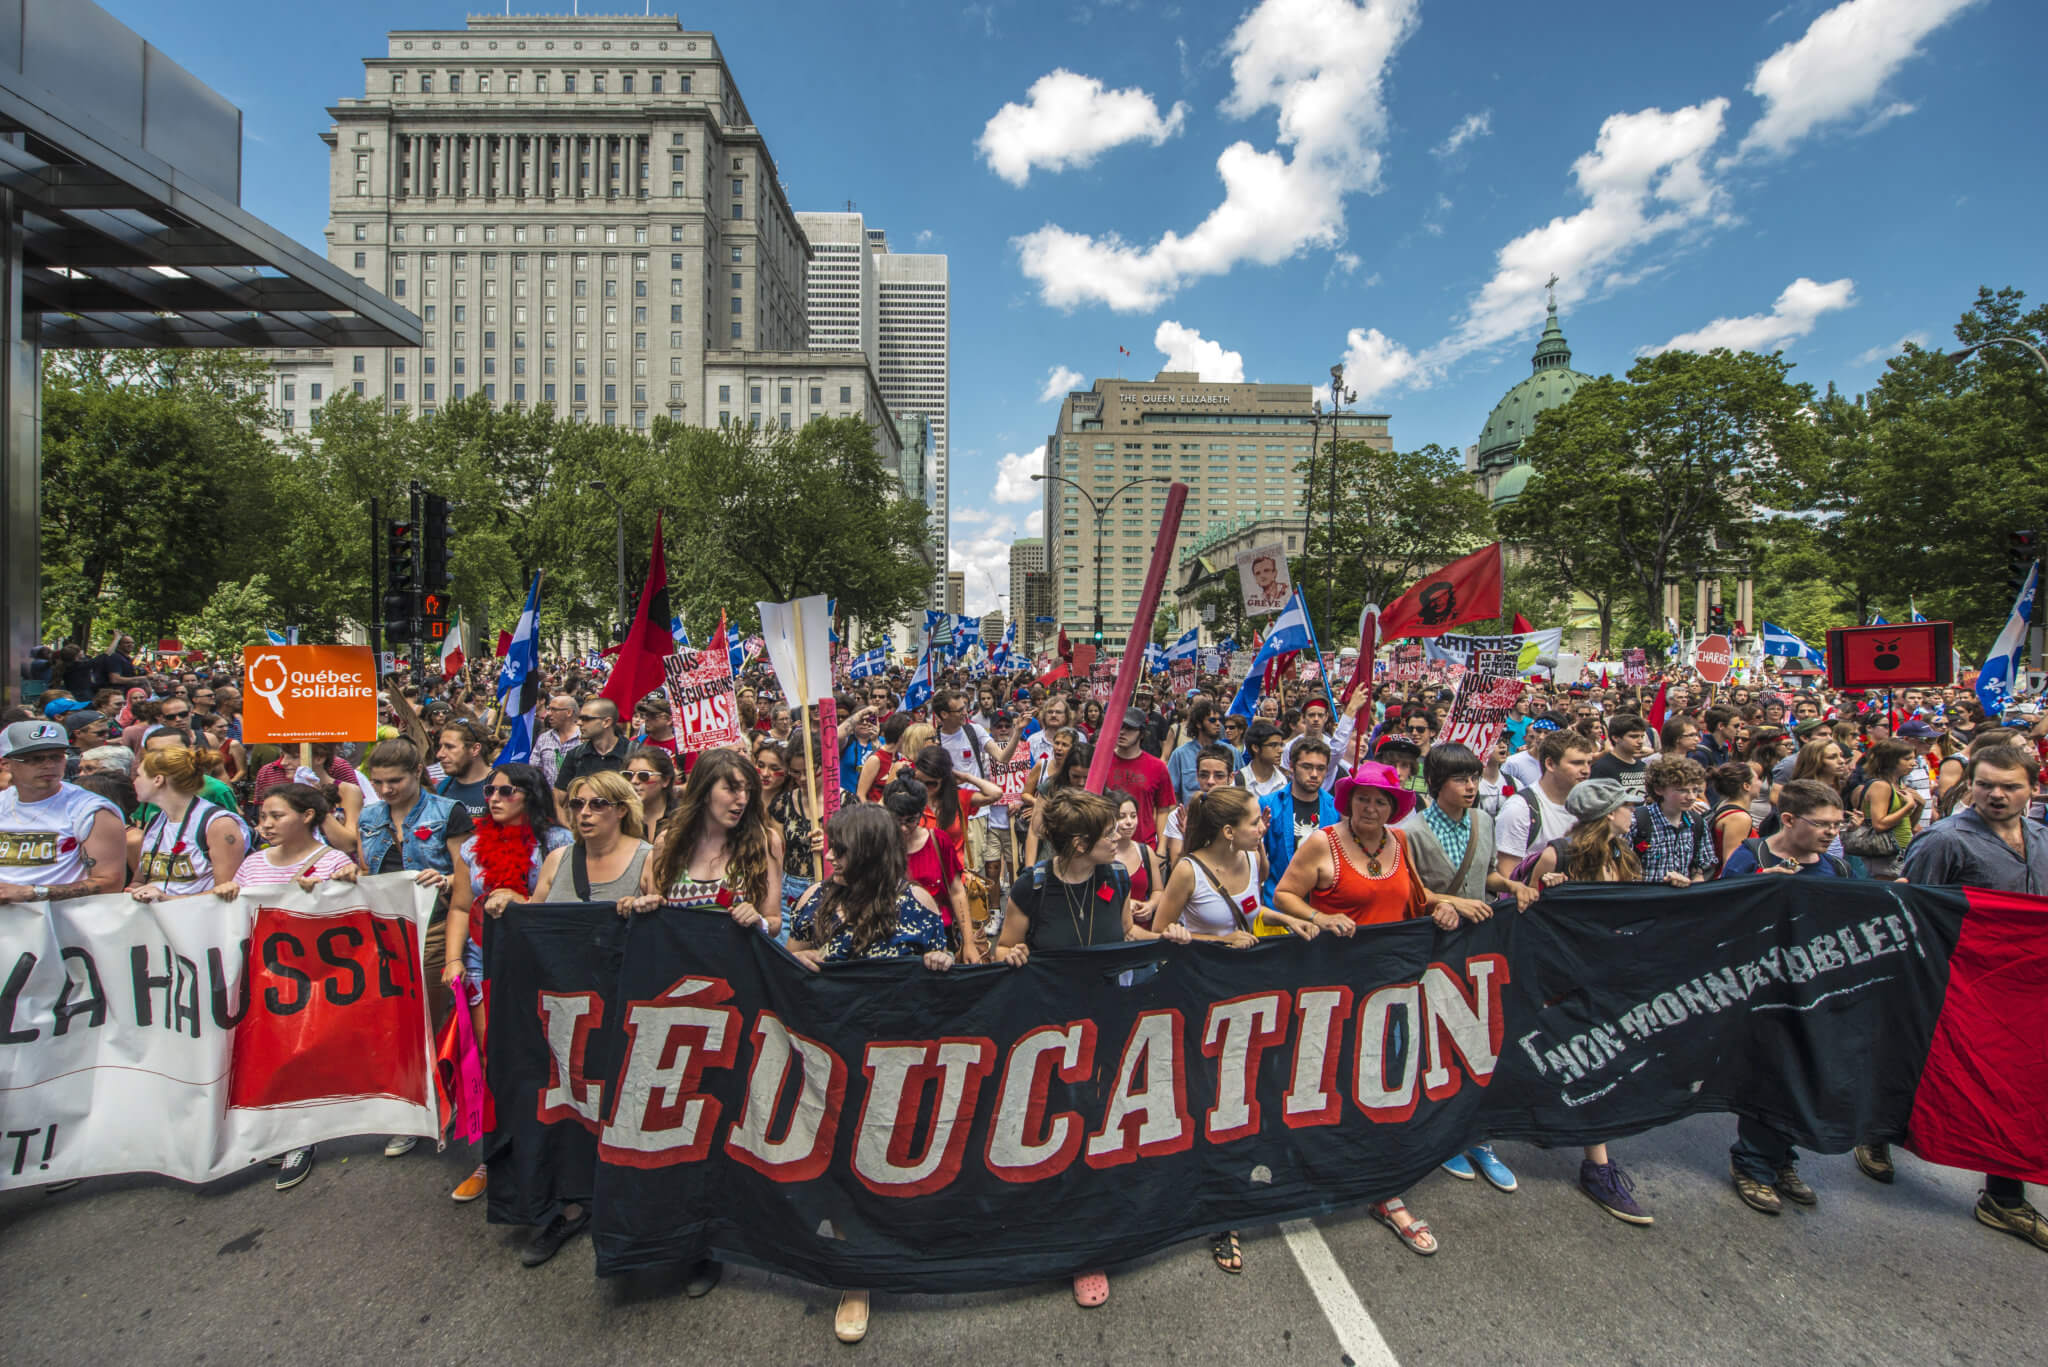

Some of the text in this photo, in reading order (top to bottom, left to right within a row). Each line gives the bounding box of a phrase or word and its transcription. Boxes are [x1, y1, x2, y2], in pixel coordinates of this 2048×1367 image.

[1119, 394, 1230, 404] THE QUEEN ELIZABETH
[1434, 634, 1525, 653] ARTISTES
[662, 653, 700, 675] NOUS
[1399, 662, 1416, 675] PAS
[1628, 666, 1643, 678] PAS
[290, 670, 362, 685] Québec
[1461, 671, 1496, 694] NOUS
[291, 685, 372, 698] solidaire
[673, 676, 734, 708] RECULERONS
[683, 694, 730, 733] PAS
[1448, 721, 1494, 757] PAS
[996, 770, 1025, 794] PAS
[17, 841, 53, 860] PLQ
[0, 917, 417, 1044] LA HAUSSE!
[1544, 914, 1909, 1084] NON MONNAYABLE!
